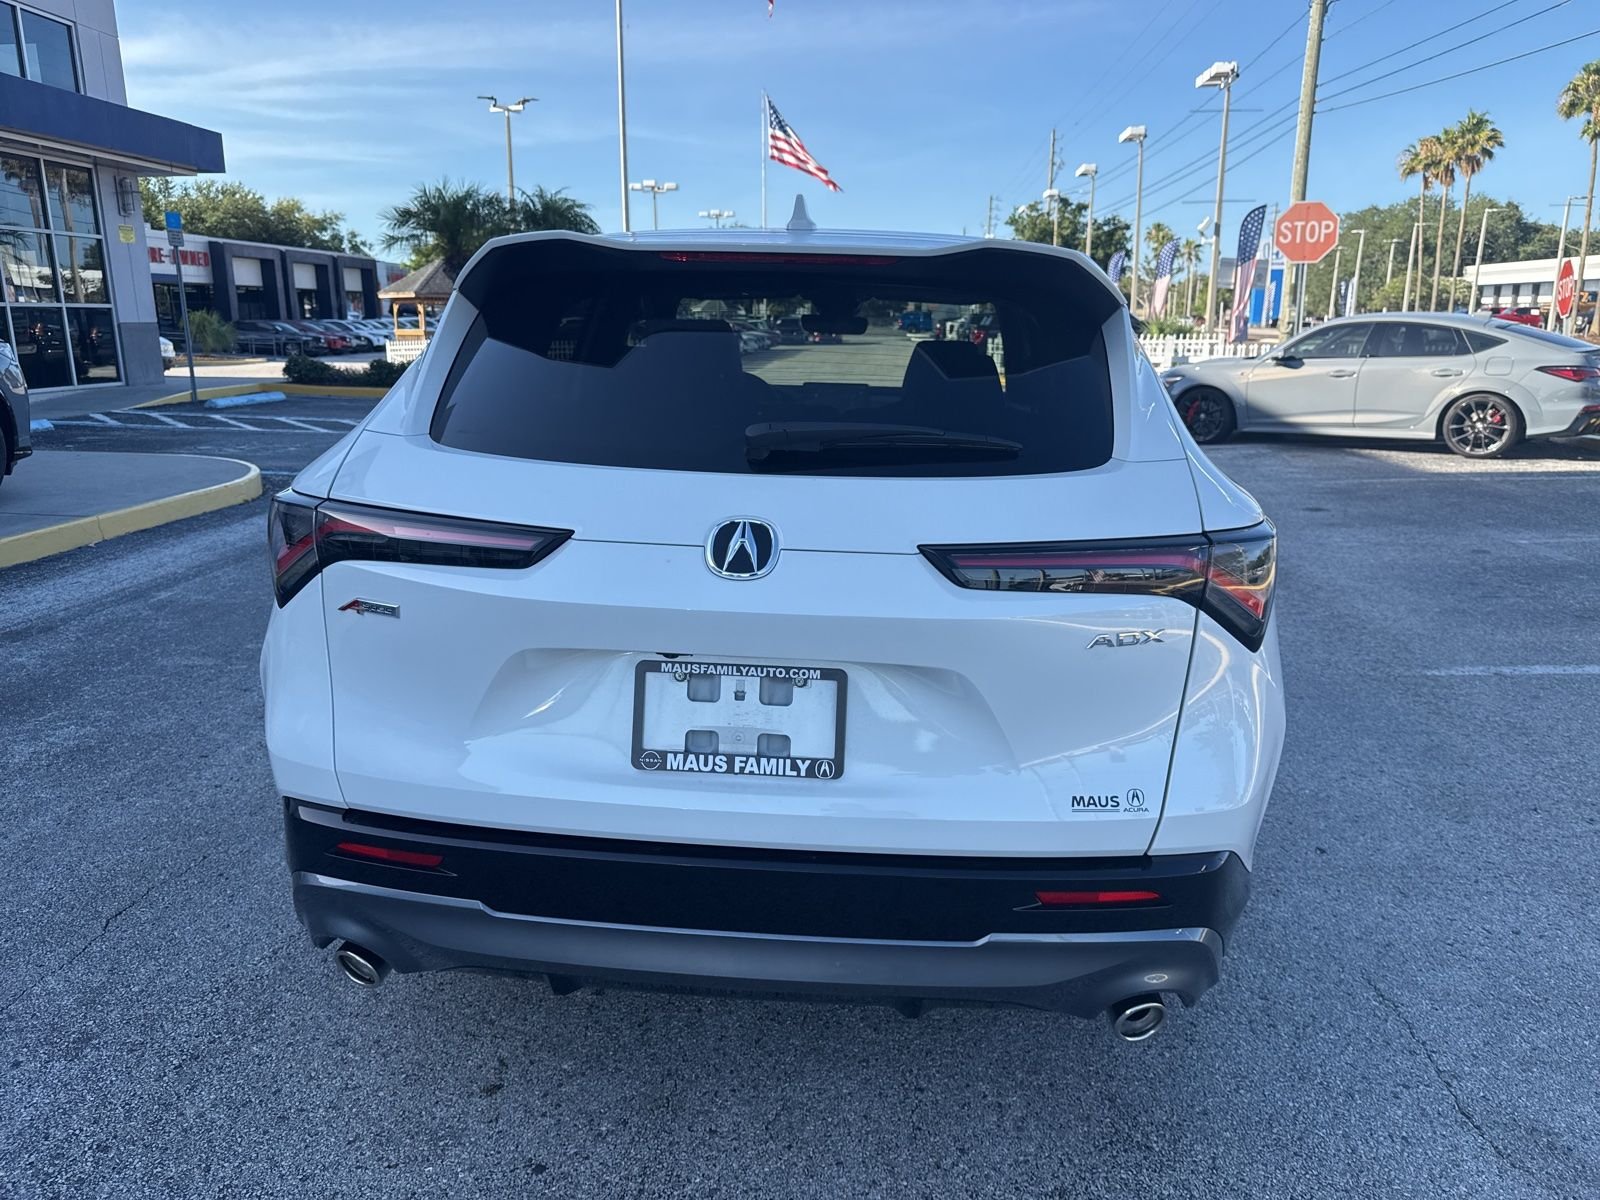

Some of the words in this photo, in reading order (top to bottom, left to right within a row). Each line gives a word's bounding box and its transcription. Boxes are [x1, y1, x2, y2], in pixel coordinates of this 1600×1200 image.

[1279, 220, 1335, 244] STOP
[148, 246, 209, 267] RE-OWNED
[1558, 275, 1574, 301] STOP
[1085, 628, 1166, 650] ADX
[660, 662, 821, 680] MAUSFAMILYAUTO.COM
[666, 752, 728, 773] MAUS
[734, 756, 812, 777] FAMILY
[1071, 795, 1120, 808] MAUS
